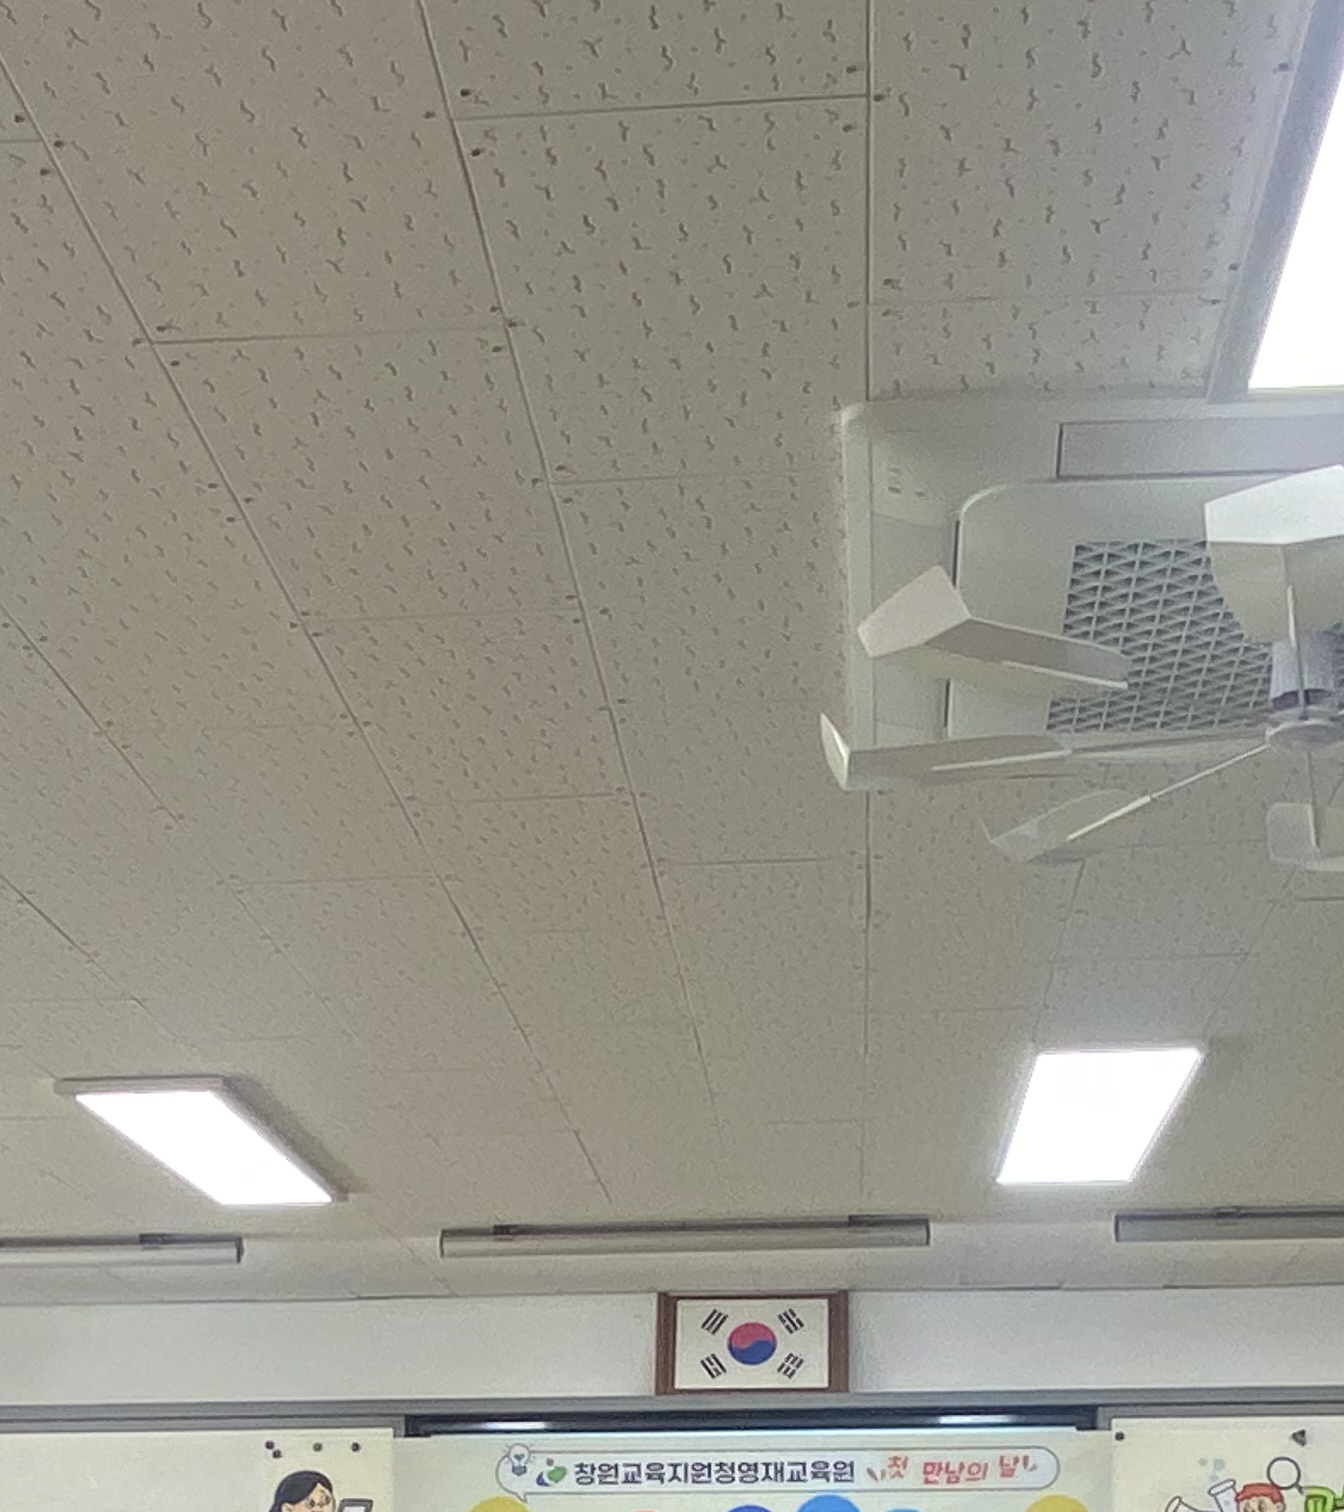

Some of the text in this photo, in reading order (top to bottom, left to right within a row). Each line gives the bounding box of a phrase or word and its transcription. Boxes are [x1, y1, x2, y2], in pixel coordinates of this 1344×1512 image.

[573, 1460, 855, 1486] 창원교육지원청영재교육원
[887, 1456, 909, 1480] 첫
[922, 1460, 988, 1485] 만남의
